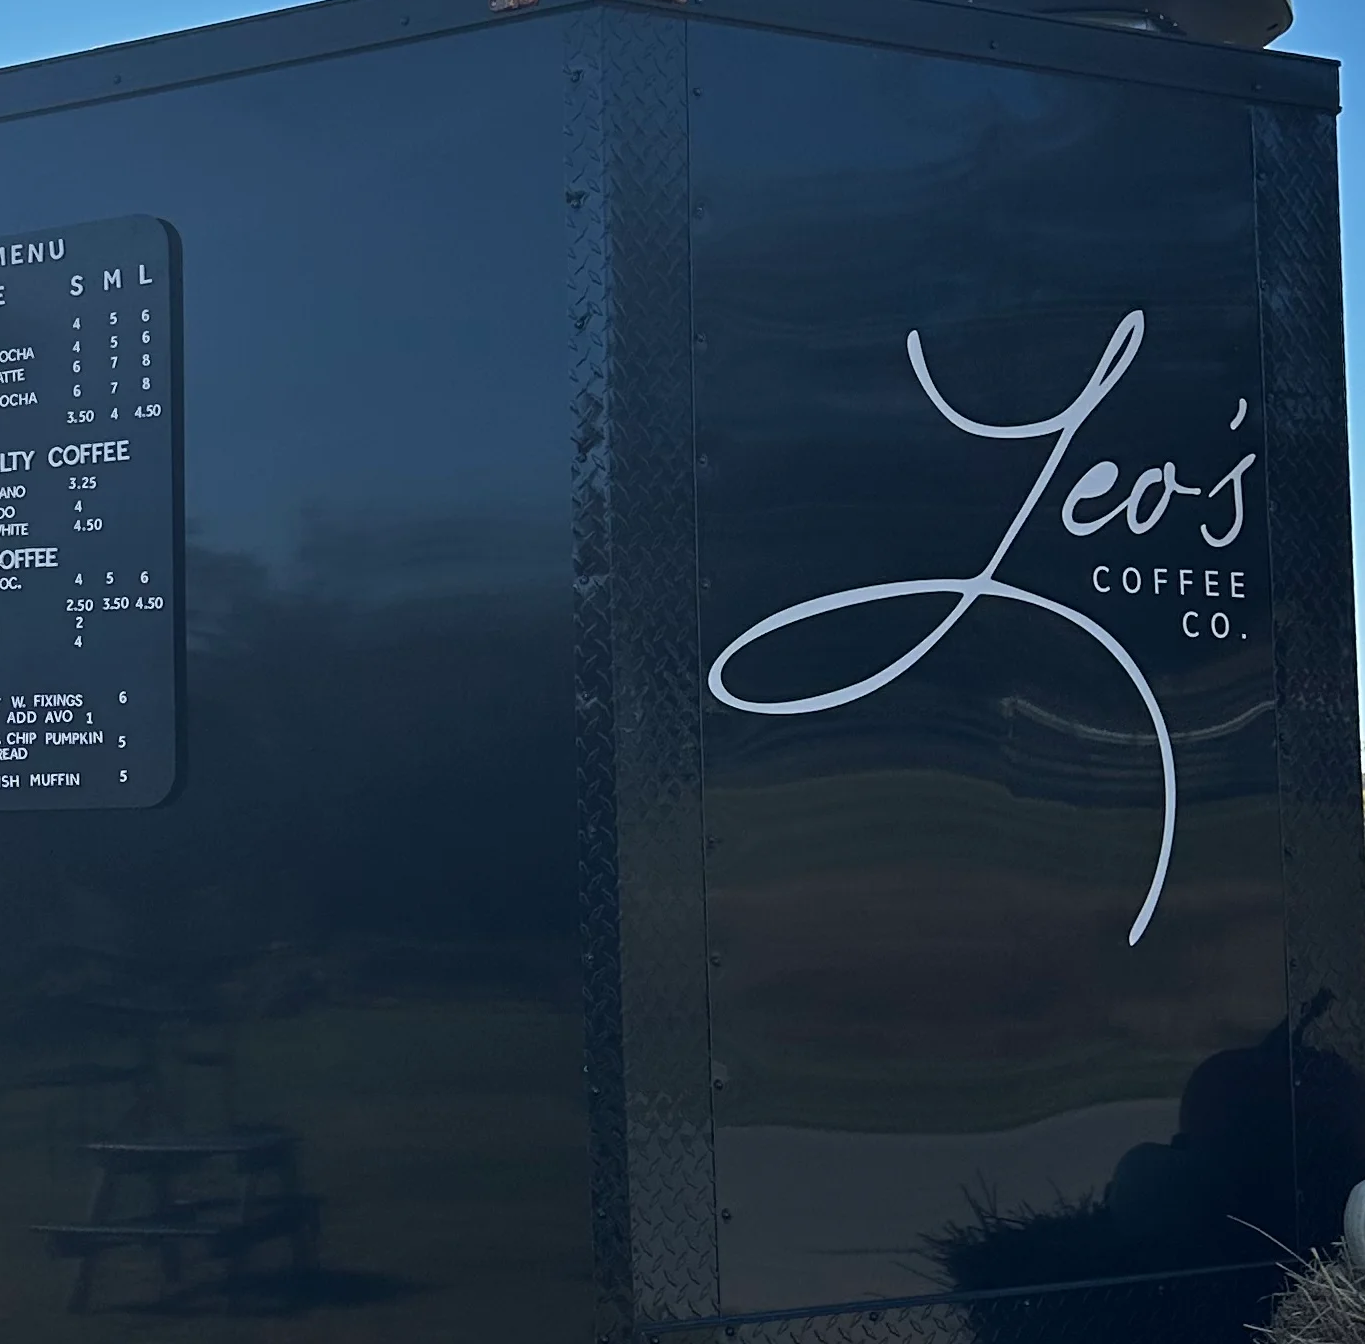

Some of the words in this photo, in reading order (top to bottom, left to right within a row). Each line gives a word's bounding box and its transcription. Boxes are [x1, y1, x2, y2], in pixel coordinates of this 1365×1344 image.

[70, 275, 83, 295] S
[104, 269, 121, 290] M
[140, 265, 152, 284] L
[72, 318, 81, 330] 4
[109, 312, 118, 325] 5
[141, 309, 150, 322] 6
[72, 341, 81, 353] 4
[110, 336, 119, 349] 5
[141, 331, 151, 344] 6
[72, 361, 81, 373] 6
[110, 356, 118, 369] 7
[141, 354, 151, 367] 8
[73, 385, 82, 398] 6
[110, 382, 119, 394] 7
[141, 378, 151, 390] 8
[67, 410, 94, 423] 3.50
[110, 408, 119, 420] 4
[135, 404, 161, 418] 4.50
[48, 440, 130, 467] COFFEE
[69, 477, 96, 489] 3.25
[74, 501, 83, 513] 4
[74, 519, 102, 531] 4.50
[74, 574, 83, 586] 4
[105, 572, 114, 585] 5
[140, 571, 149, 584] 6
[1092, 565, 1246, 599] COFFEE
[67, 599, 93, 611] 2.50
[103, 597, 129, 610] 3.50
[135, 597, 163, 609] 4.50
[75, 617, 84, 629] 2
[1182, 611, 1247, 640] CO.
[73, 636, 83, 648] 4
[11, 696, 26, 708] W.
[34, 694, 83, 707] FIXINGS
[118, 691, 128, 704] 6
[7, 711, 37, 723] ADD
[45, 710, 73, 723] AVO
[86, 712, 94, 725] 1
[7, 733, 36, 744] CHIP
[46, 731, 103, 745] PUMPKIN
[118, 736, 127, 749] 5
[30, 773, 79, 786] MUFFIN
[119, 770, 128, 783] 5
